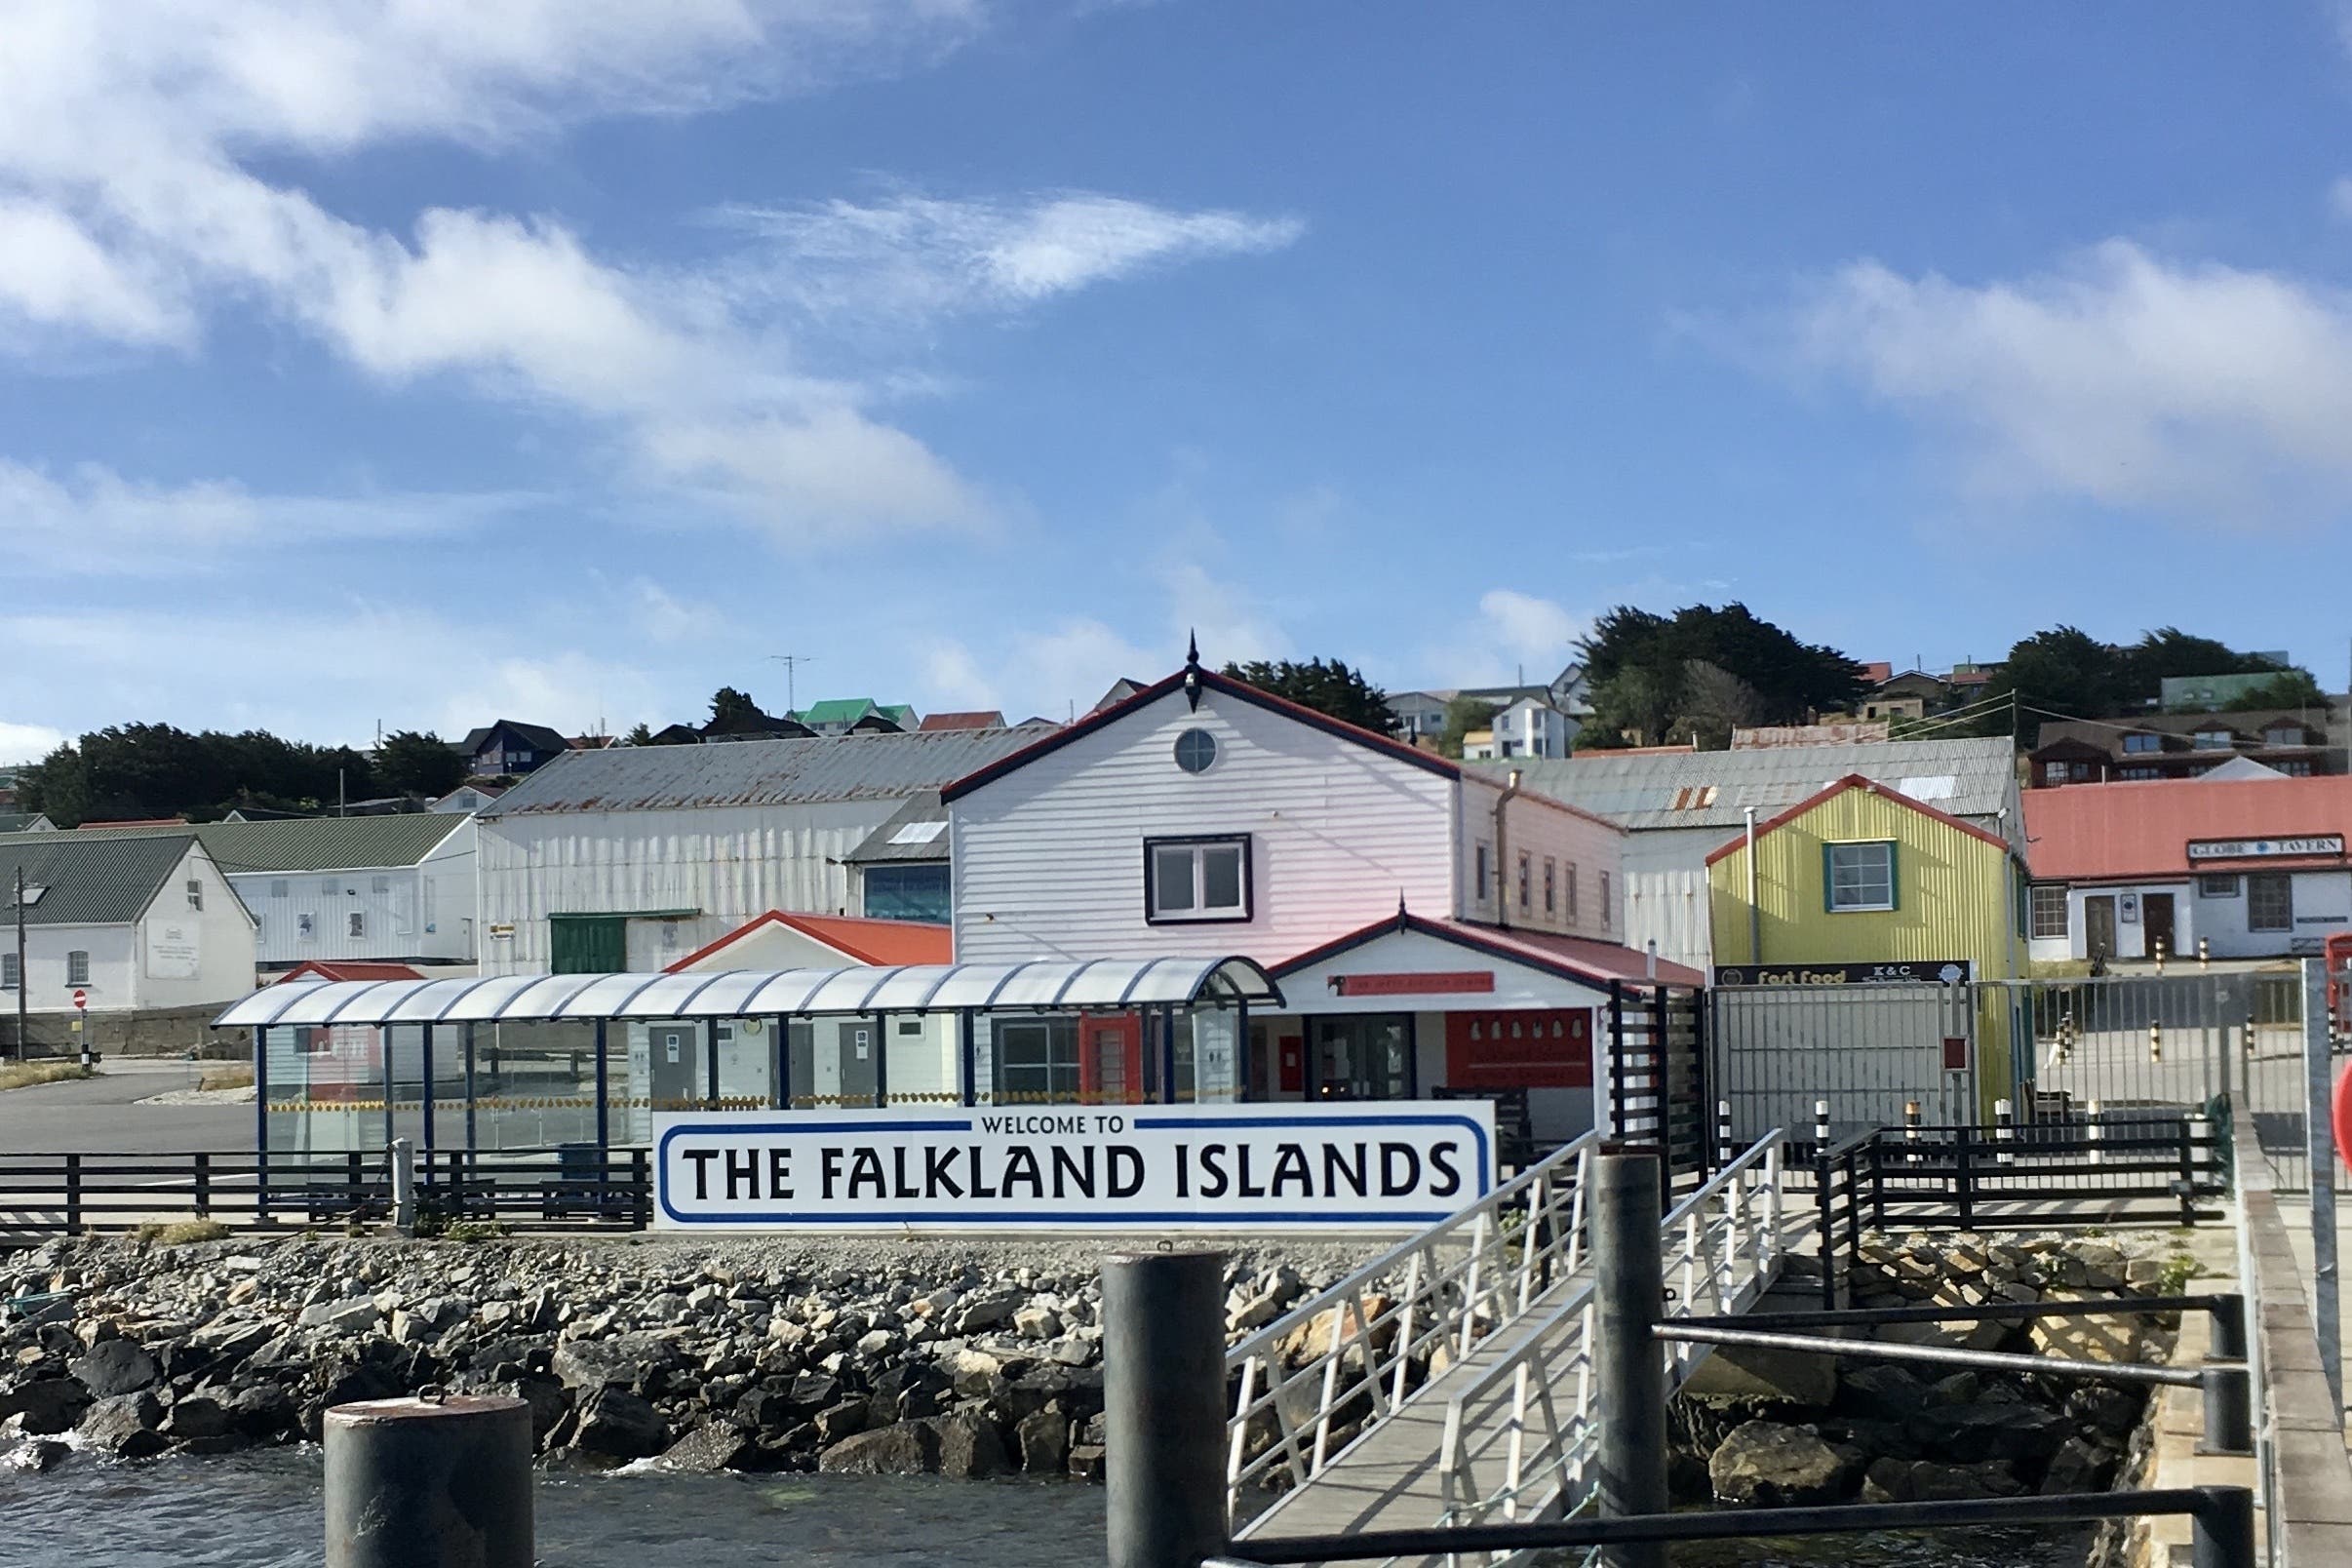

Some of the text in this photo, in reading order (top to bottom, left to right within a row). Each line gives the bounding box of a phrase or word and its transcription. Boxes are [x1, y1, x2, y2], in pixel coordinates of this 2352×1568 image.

[2278, 838, 2337, 852] TAVERN
[1886, 966, 1897, 976] &
[1899, 965, 1911, 976] C
[982, 1116, 1124, 1135] WELCOME TO
[682, 1141, 1461, 1200] THE FALKLAND ISLANDS
